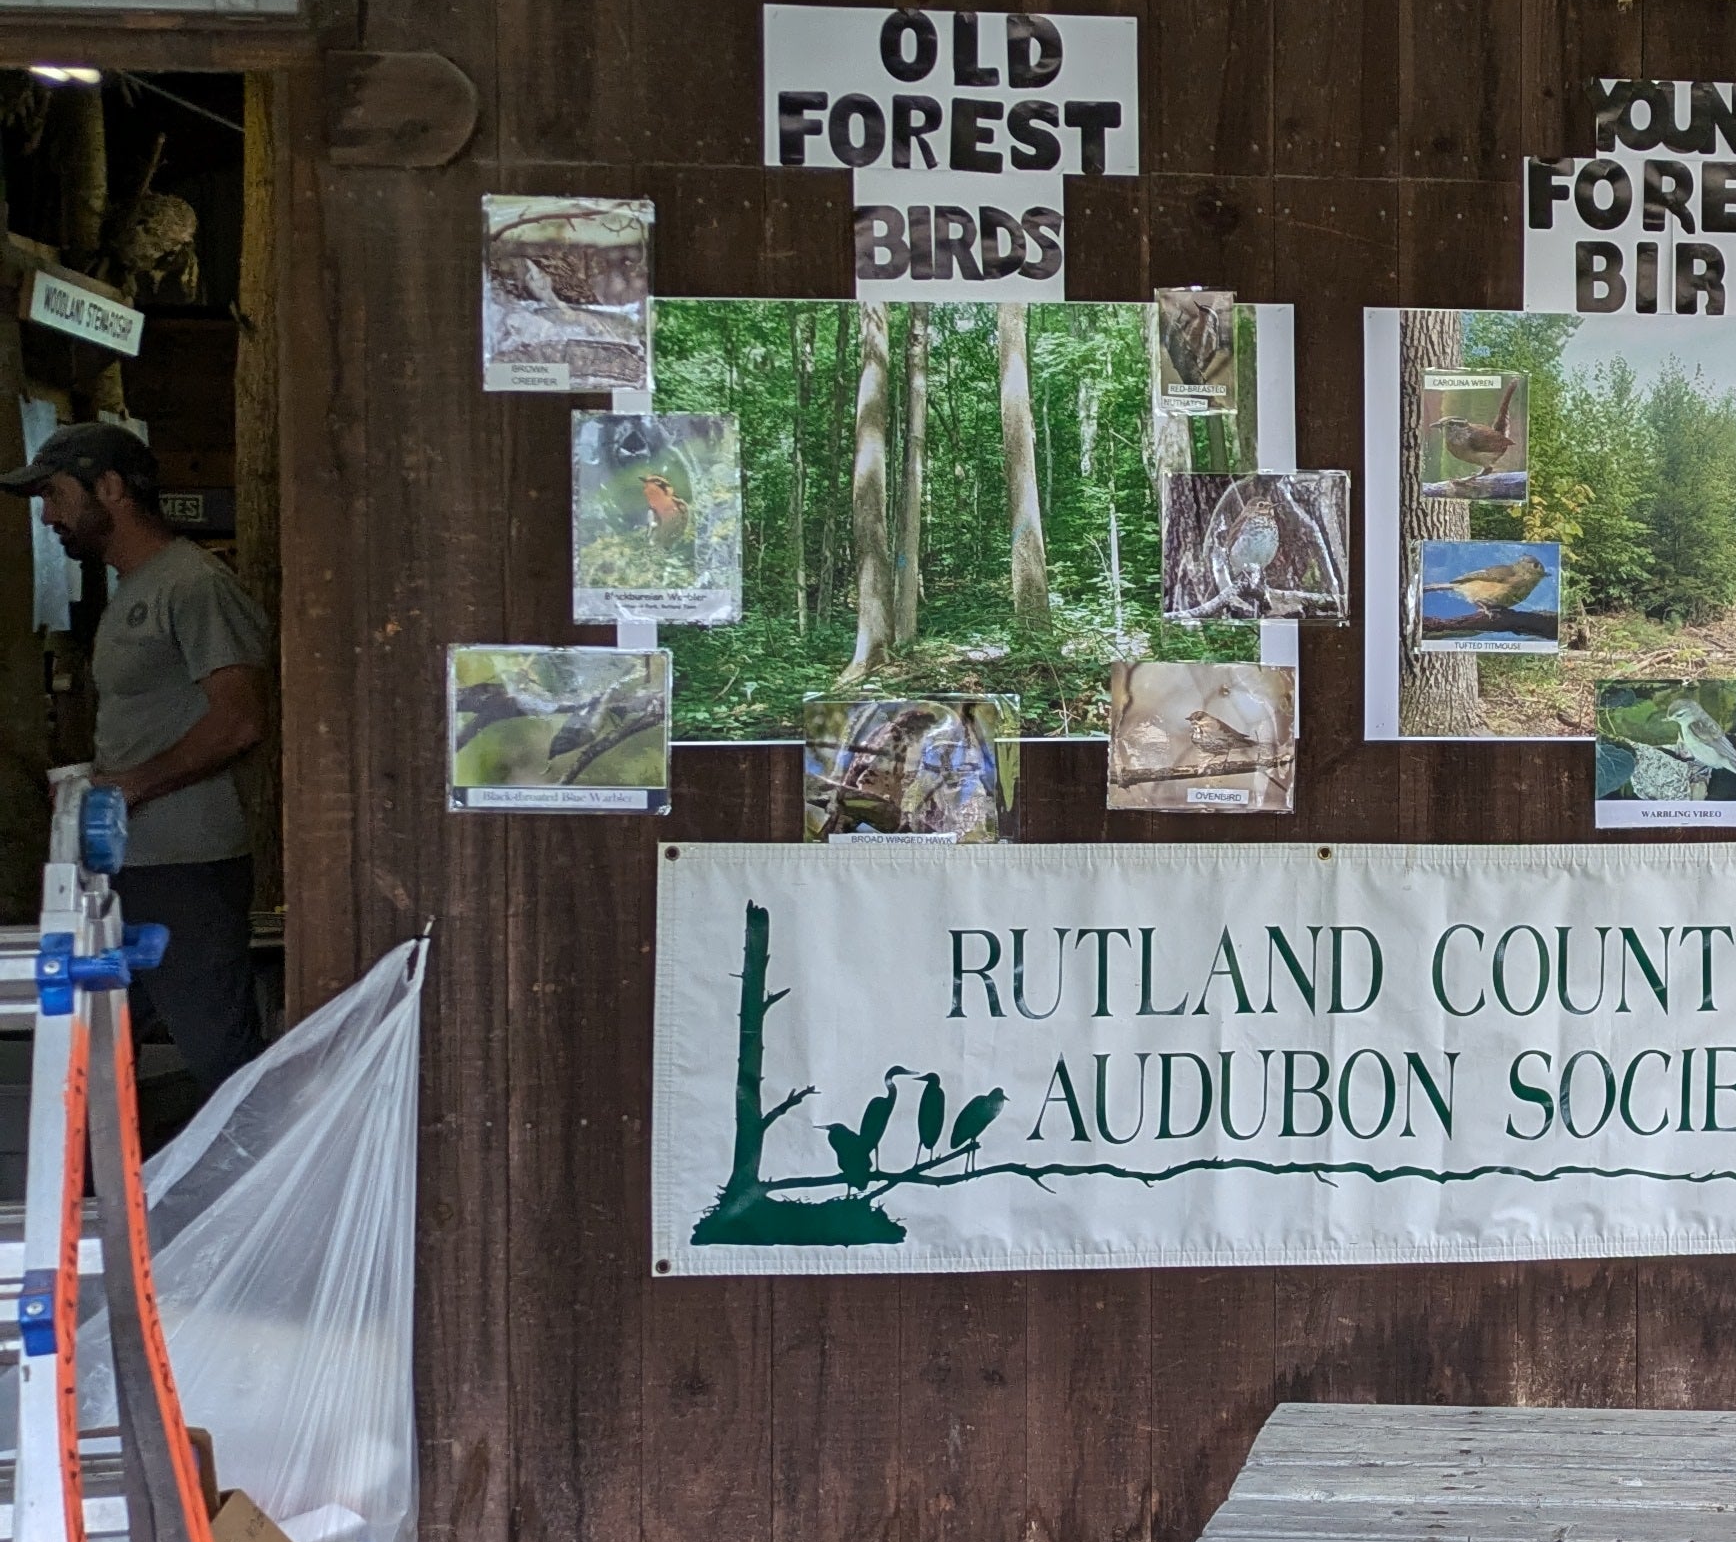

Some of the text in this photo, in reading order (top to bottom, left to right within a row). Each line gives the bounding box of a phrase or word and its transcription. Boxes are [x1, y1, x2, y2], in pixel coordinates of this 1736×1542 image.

[880, 9, 1063, 88] OLD
[778, 91, 1122, 174] FOREST
[853, 205, 1064, 280] BIRDS
[511, 364, 549, 373] BROWN
[511, 376, 558, 386] CREEPER
[1432, 378, 1494, 387] CAROLINA WREN
[1170, 385, 1226, 394] RED-BREASTED
[1455, 641, 1521, 650] TUFTED TITMOUSE
[483, 791, 633, 803] Black-throated Blue Warbler
[1195, 791, 1242, 802] OVENBIRD
[1641, 810, 1722, 818] WARBLING VIREO
[851, 835, 953, 844] BROAD WINGED HAWK
[945, 924, 1384, 1020] RUTLAND
[1026, 1048, 1461, 1144] AUDUBON
